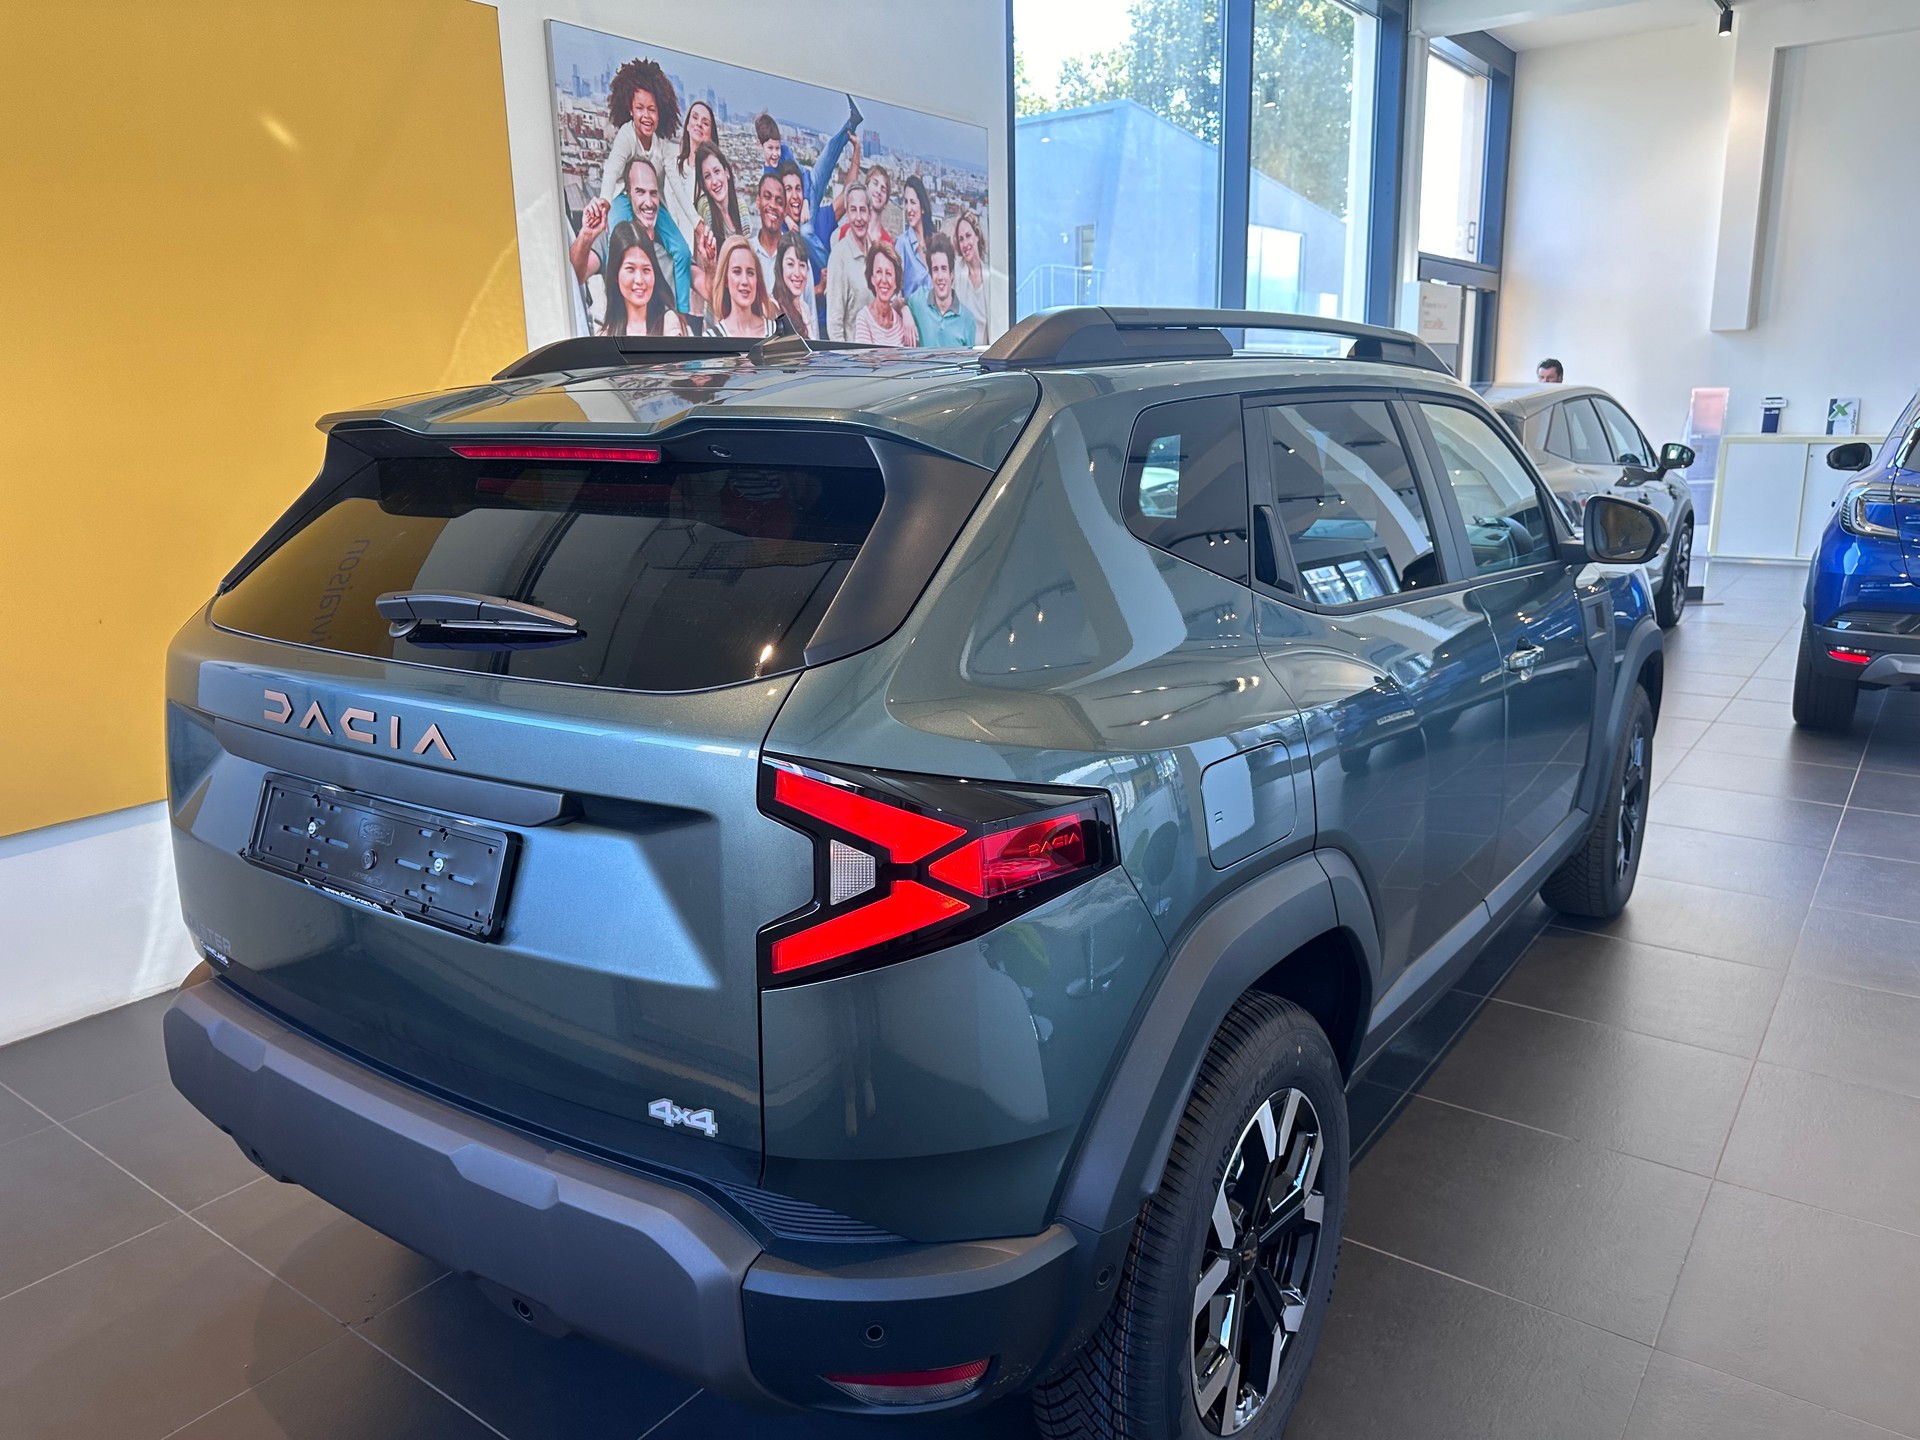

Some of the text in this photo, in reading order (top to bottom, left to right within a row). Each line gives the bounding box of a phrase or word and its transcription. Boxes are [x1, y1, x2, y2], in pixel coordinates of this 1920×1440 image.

[264, 689, 456, 761] DACIA
[1028, 832, 1080, 857] DACIA
[648, 1098, 718, 1138] 4x4
